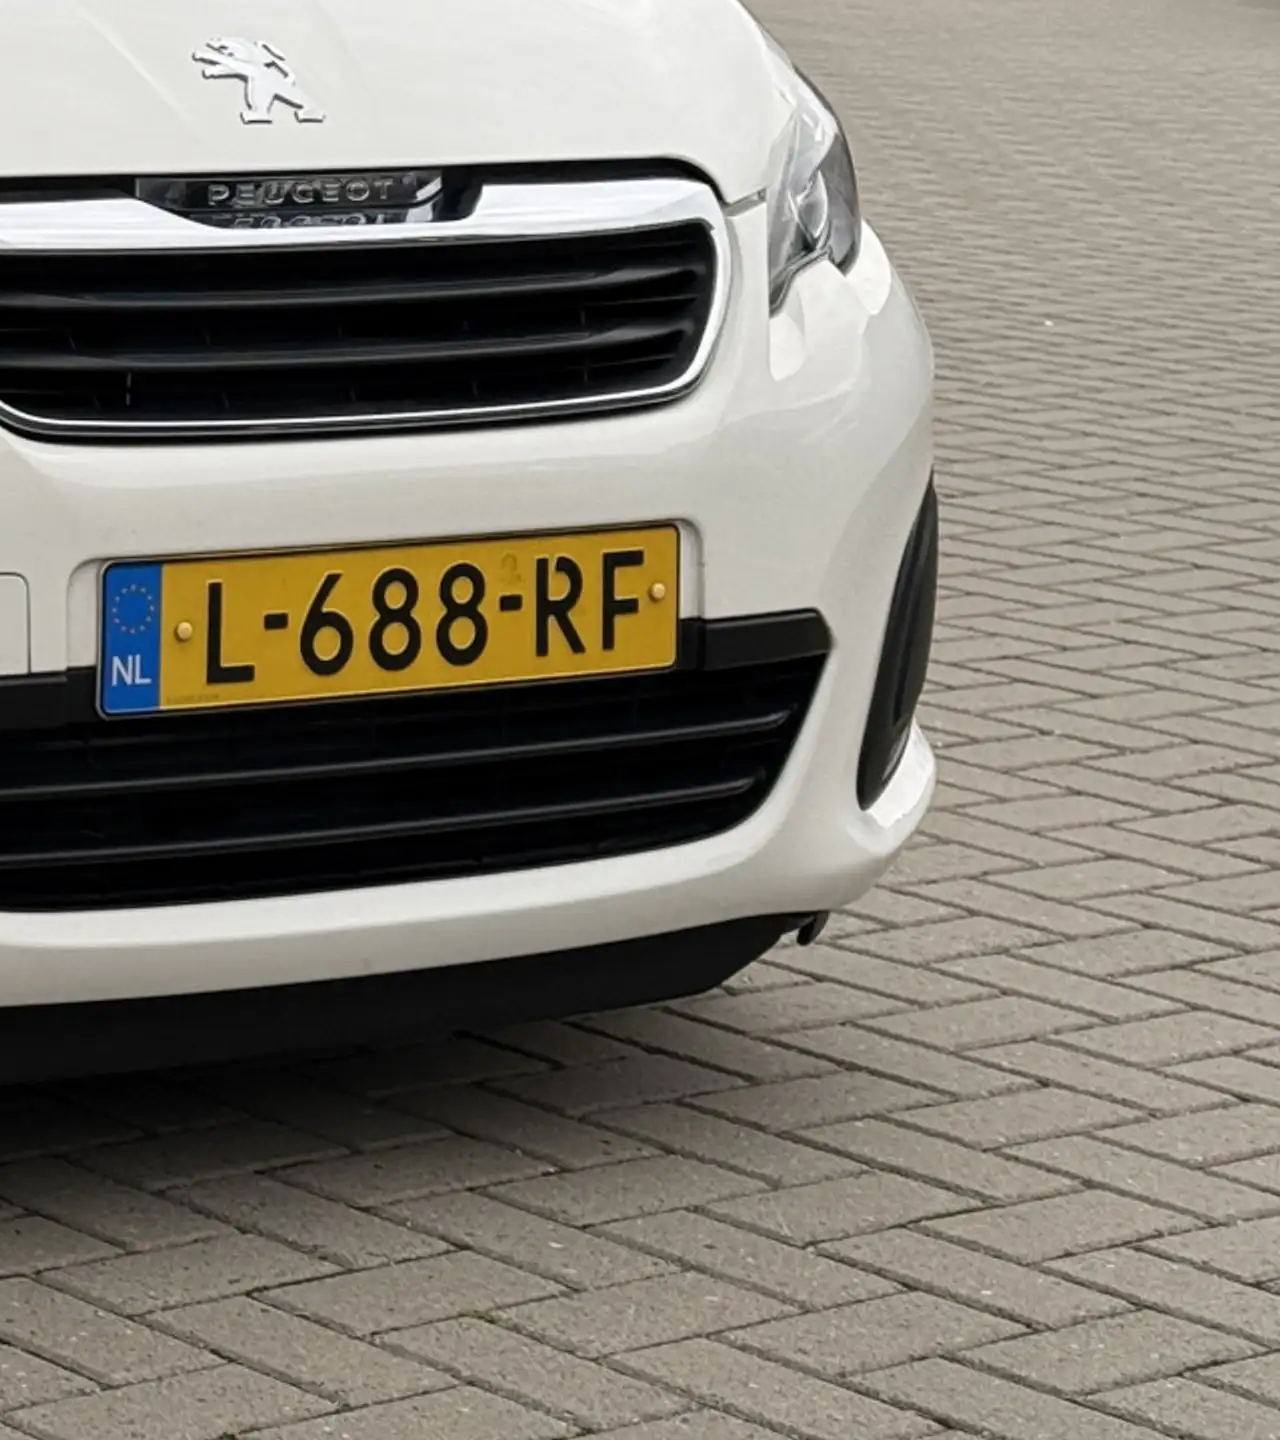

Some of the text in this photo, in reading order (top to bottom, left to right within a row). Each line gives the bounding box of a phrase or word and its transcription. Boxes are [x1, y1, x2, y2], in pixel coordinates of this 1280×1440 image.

[207, 177, 394, 206] PEUGEOT
[206, 548, 646, 685] L-688-RF
[111, 655, 152, 686] NL
